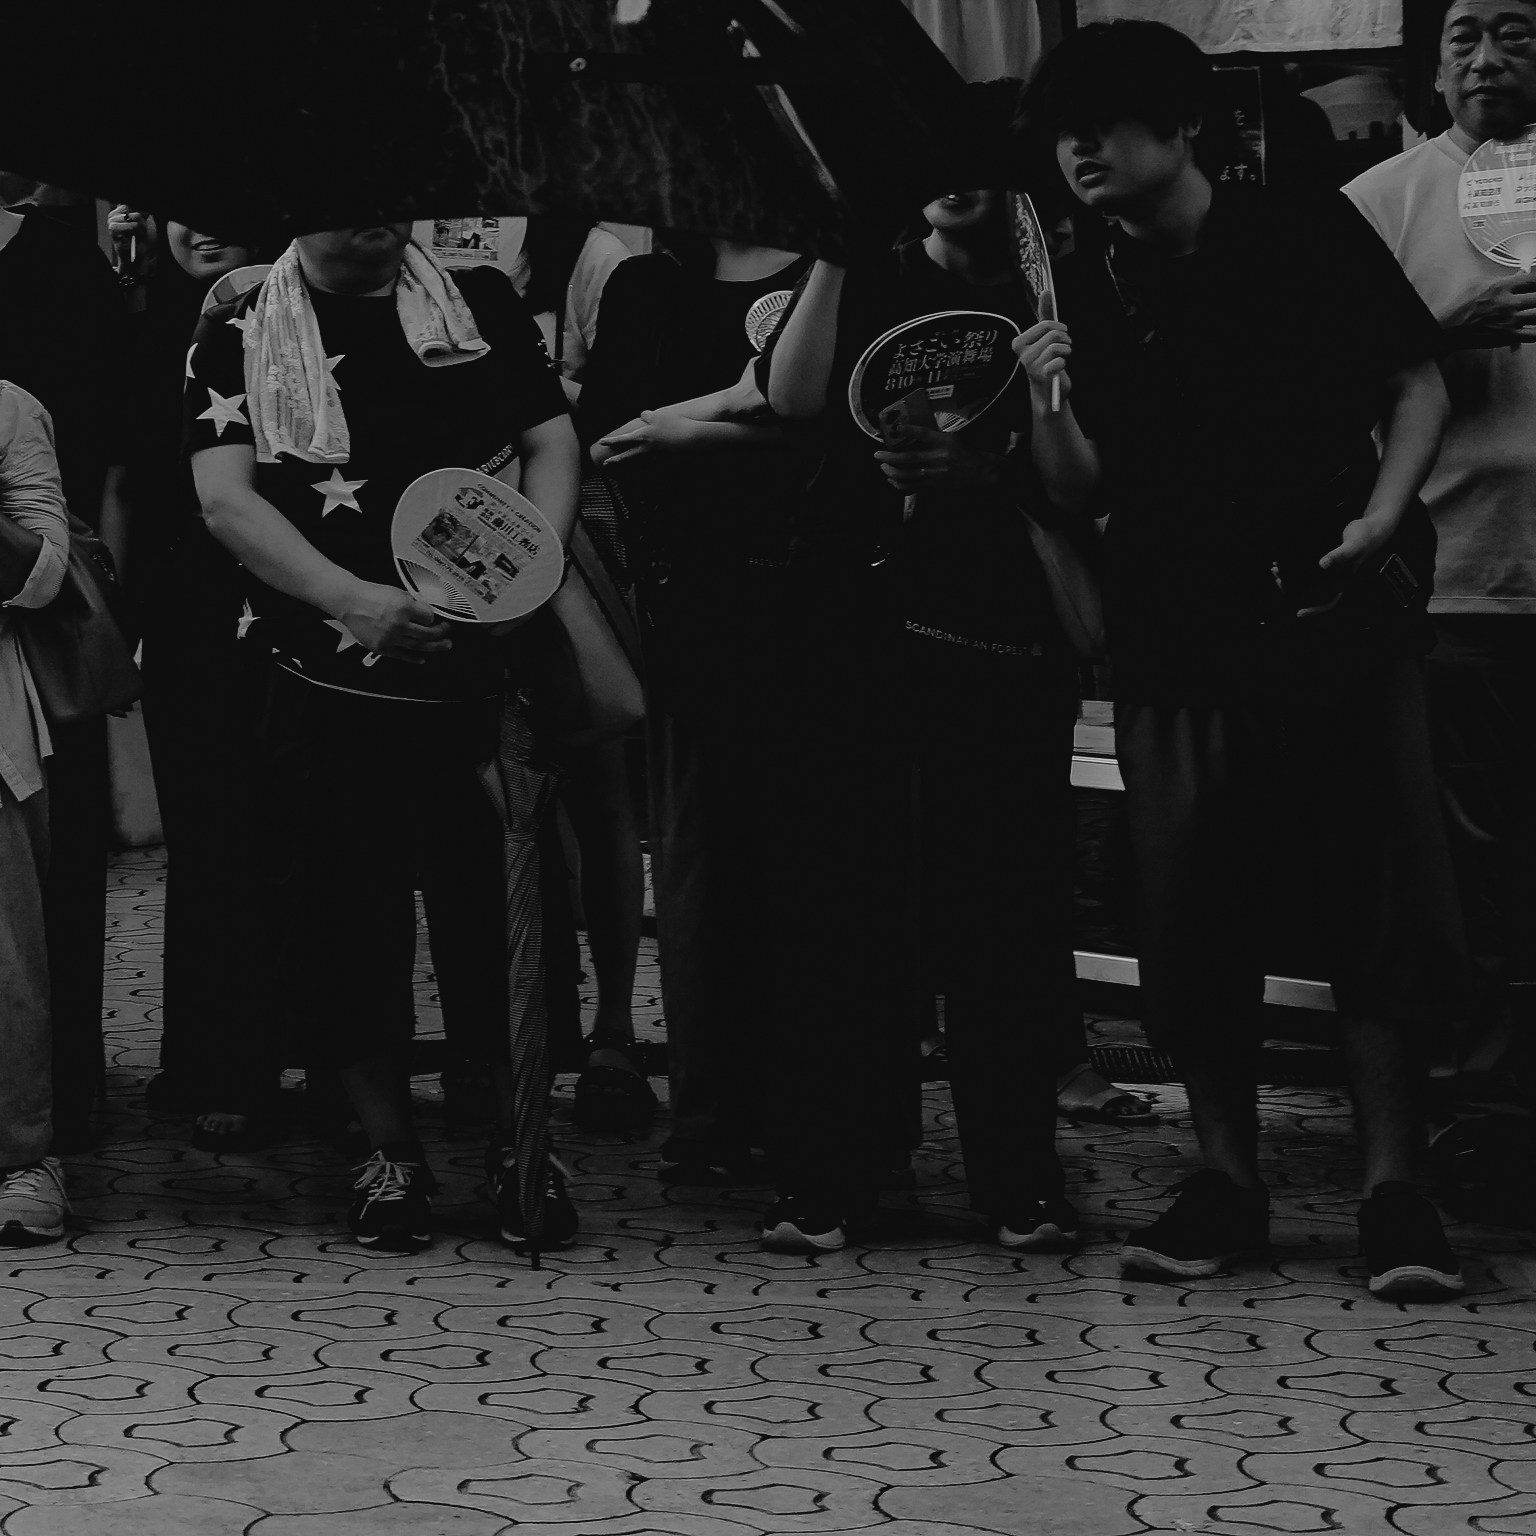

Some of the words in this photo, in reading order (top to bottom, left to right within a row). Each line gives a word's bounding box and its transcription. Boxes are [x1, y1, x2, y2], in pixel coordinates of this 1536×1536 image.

[893, 329, 998, 359] よさこい祭り
